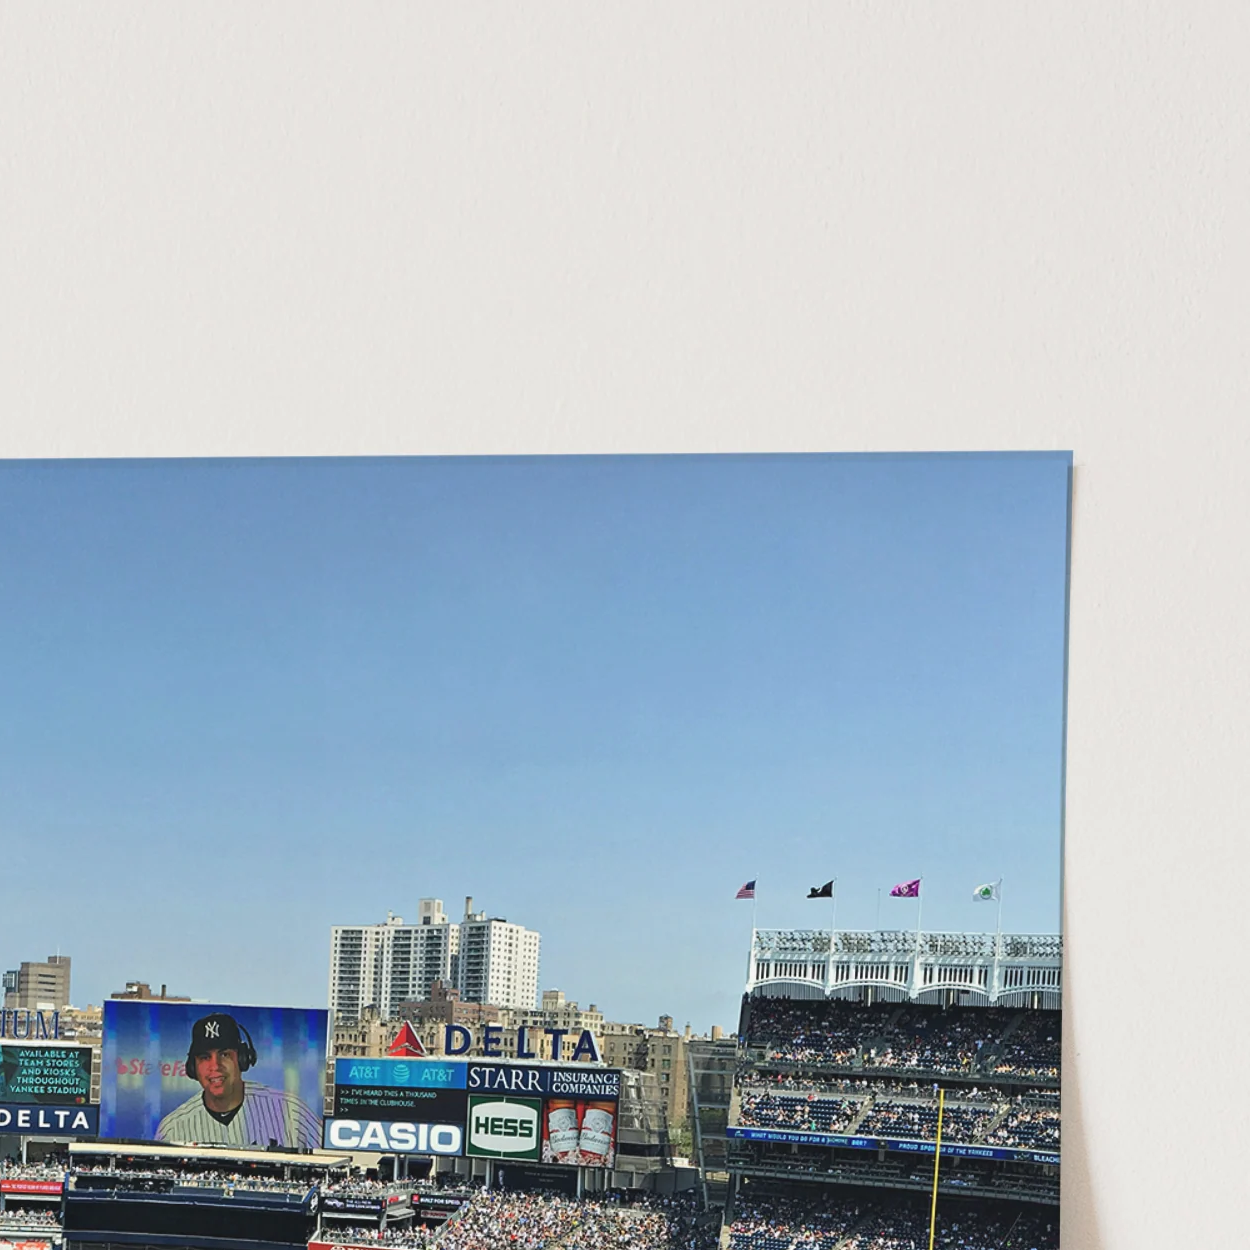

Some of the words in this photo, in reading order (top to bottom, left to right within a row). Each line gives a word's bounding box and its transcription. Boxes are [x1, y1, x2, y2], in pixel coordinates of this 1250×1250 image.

[445, 1025, 602, 1063] DELTA
[19, 1050, 67, 1059] AVAILABLE
[70, 1051, 80, 1059] AT
[19, 1059, 45, 1067] TEAM
[46, 1060, 80, 1068] STORES
[21, 1068, 42, 1076] AND
[44, 1068, 76, 1076] KIOSKS
[349, 1066, 381, 1079] AT&T
[421, 1068, 455, 1082] AT&T
[553, 1071, 620, 1085] INSURANCE
[17, 1077, 81, 1085] THROUGHOUT
[469, 1067, 544, 1092] STARR
[10, 1085, 46, 1094] YANKEE
[47, 1086, 87, 1095] STADIUM
[364, 1089, 383, 1097] HEARD
[405, 1091, 438, 1099] THOUSAND
[552, 1082, 620, 1096] COMPANIES
[475, 1116, 534, 1139] HESS
[330, 1120, 461, 1153] CASIO
